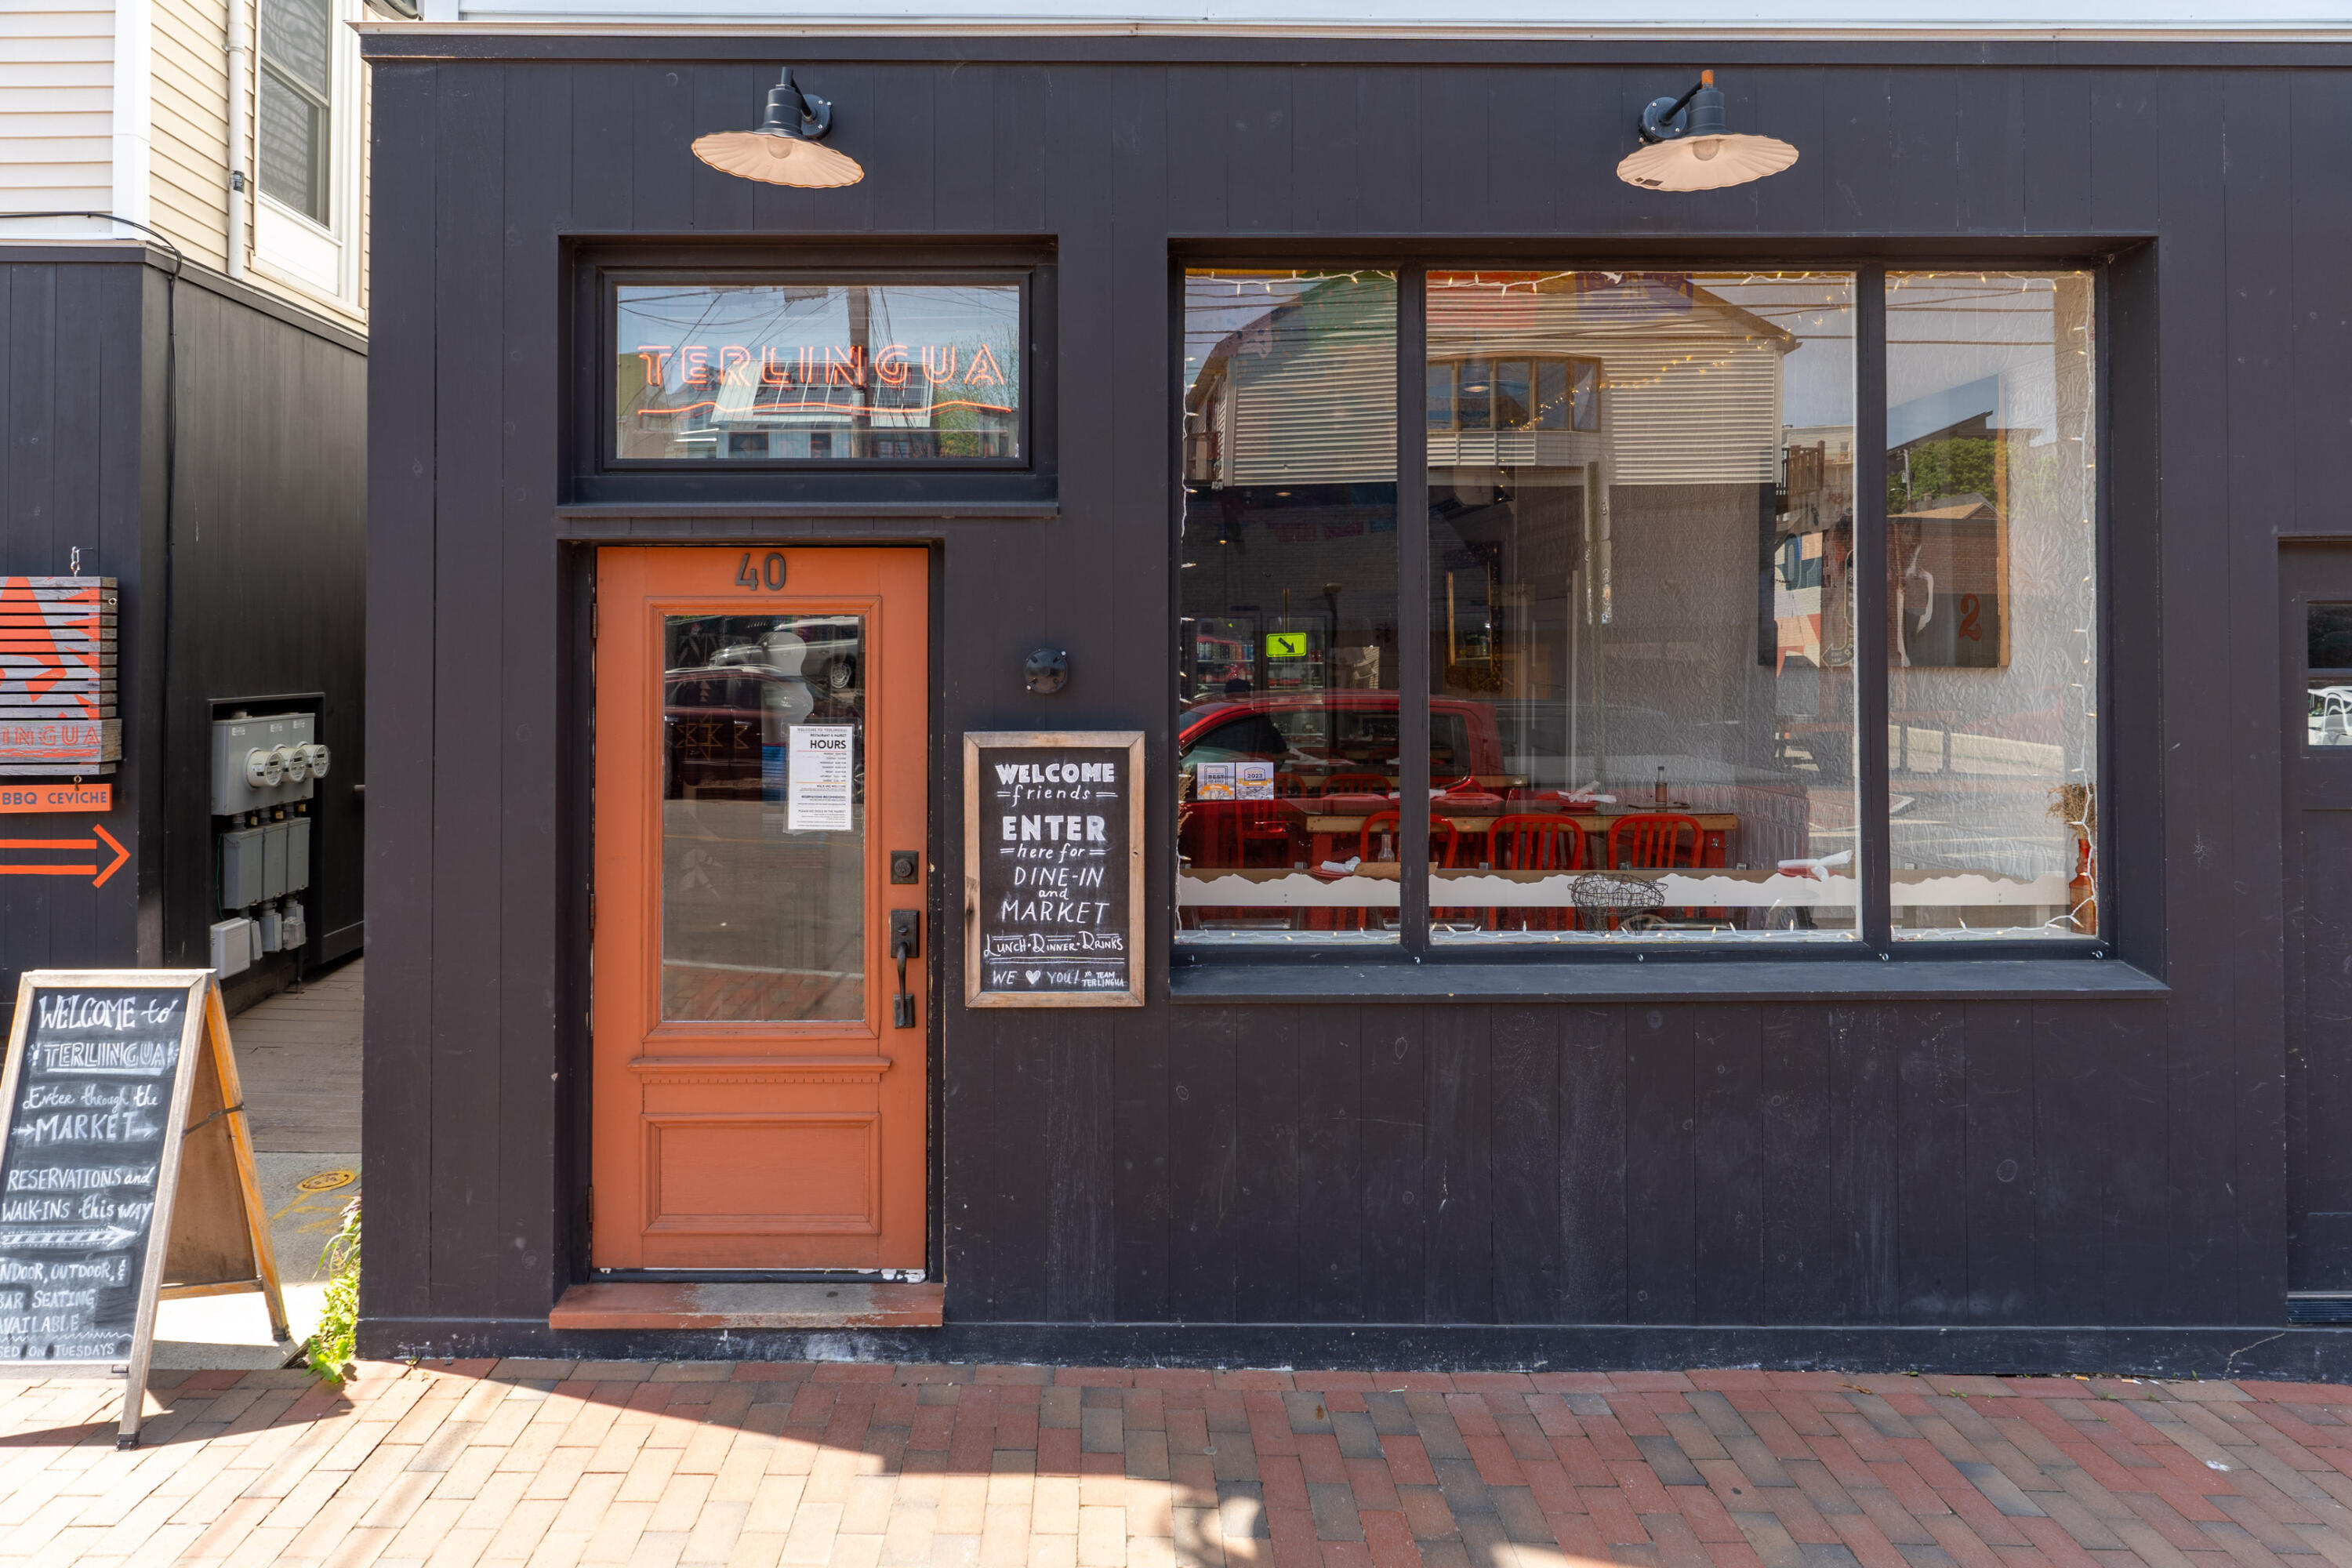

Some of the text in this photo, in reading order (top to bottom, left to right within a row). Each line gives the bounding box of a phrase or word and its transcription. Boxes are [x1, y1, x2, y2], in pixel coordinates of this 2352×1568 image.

[637, 344, 1005, 386] TERLINGUA
[735, 553, 786, 590] 40
[810, 739, 847, 749] HOURS
[995, 763, 1115, 785] WELCOME
[2, 791, 107, 805] BBQ CEVICHE
[1011, 785, 1091, 807] friends
[1002, 815, 1106, 841] ENTER
[1017, 843, 1085, 863] here for
[1014, 866, 1104, 887] DINE-IN
[1038, 887, 1069, 900] and
[1001, 900, 1110, 924] MARKET
[993, 971, 1018, 985] WE
[1082, 978, 1125, 988] TERLINGUA
[39, 995, 179, 1031] WELCOME to
[133, 1083, 158, 1107] the
[34, 1111, 139, 1142] MARKET
[6, 1166, 156, 1191] RESERVATIONS and
[2, 1199, 71, 1221] WALK-INS
[82, 1192, 114, 1220] this
[0, 1259, 48, 1283] NDOOR,
[51, 1261, 115, 1282] OUTDOOR,
[32, 1288, 97, 1310] SEATING
[29, 1345, 46, 1357] ON
[54, 1342, 115, 1357] TUESDAYS
